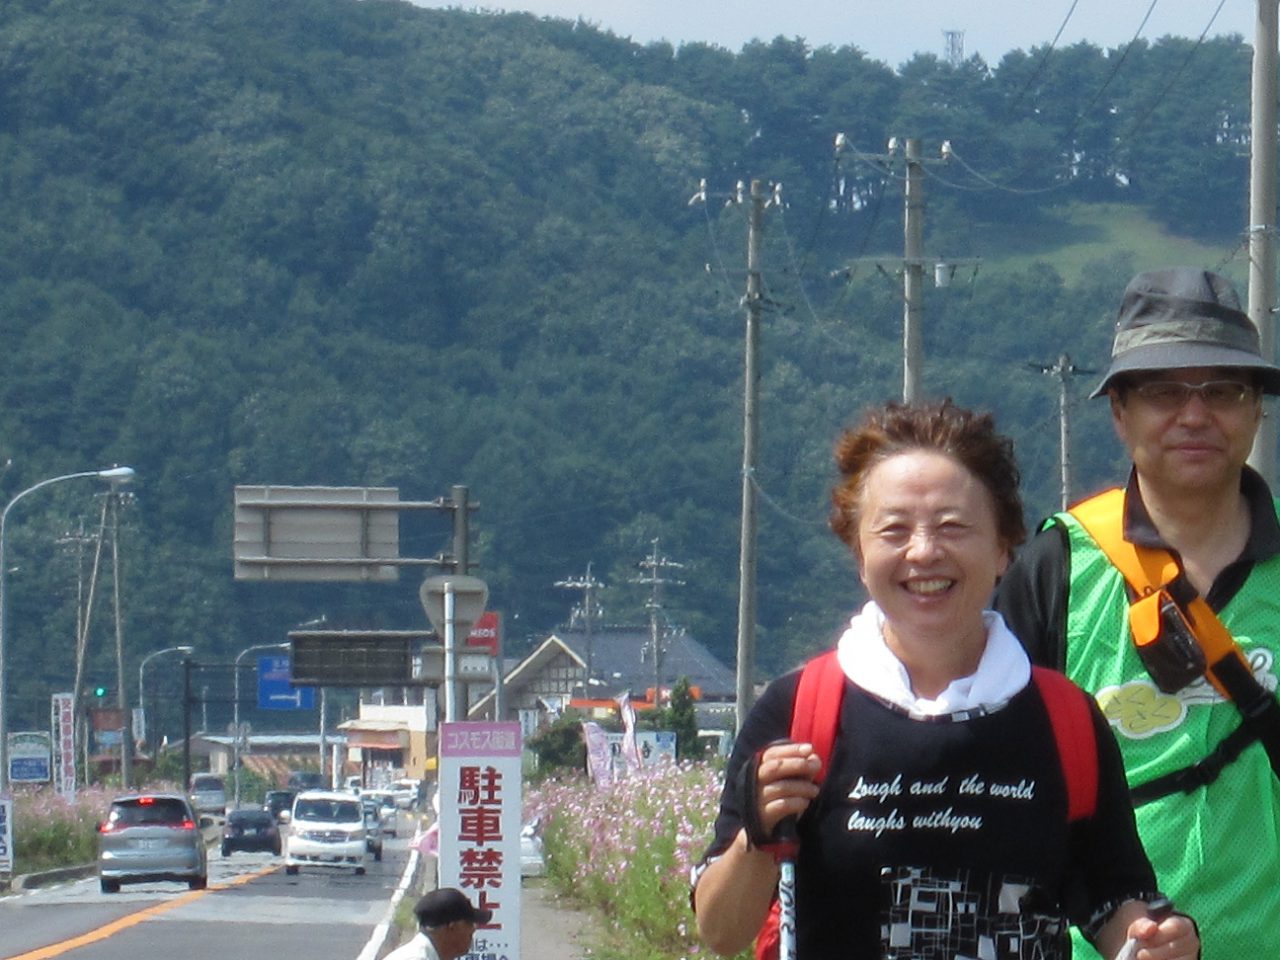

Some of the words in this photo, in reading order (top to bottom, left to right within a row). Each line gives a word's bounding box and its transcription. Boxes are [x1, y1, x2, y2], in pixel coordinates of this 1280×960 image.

[447, 730, 516, 750] コスモス街道
[910, 776, 949, 796] and
[959, 773, 985, 794] the
[990, 779, 1035, 800] world
[847, 808, 907, 838] laughs
[458, 766, 503, 930] 駐車禁止
